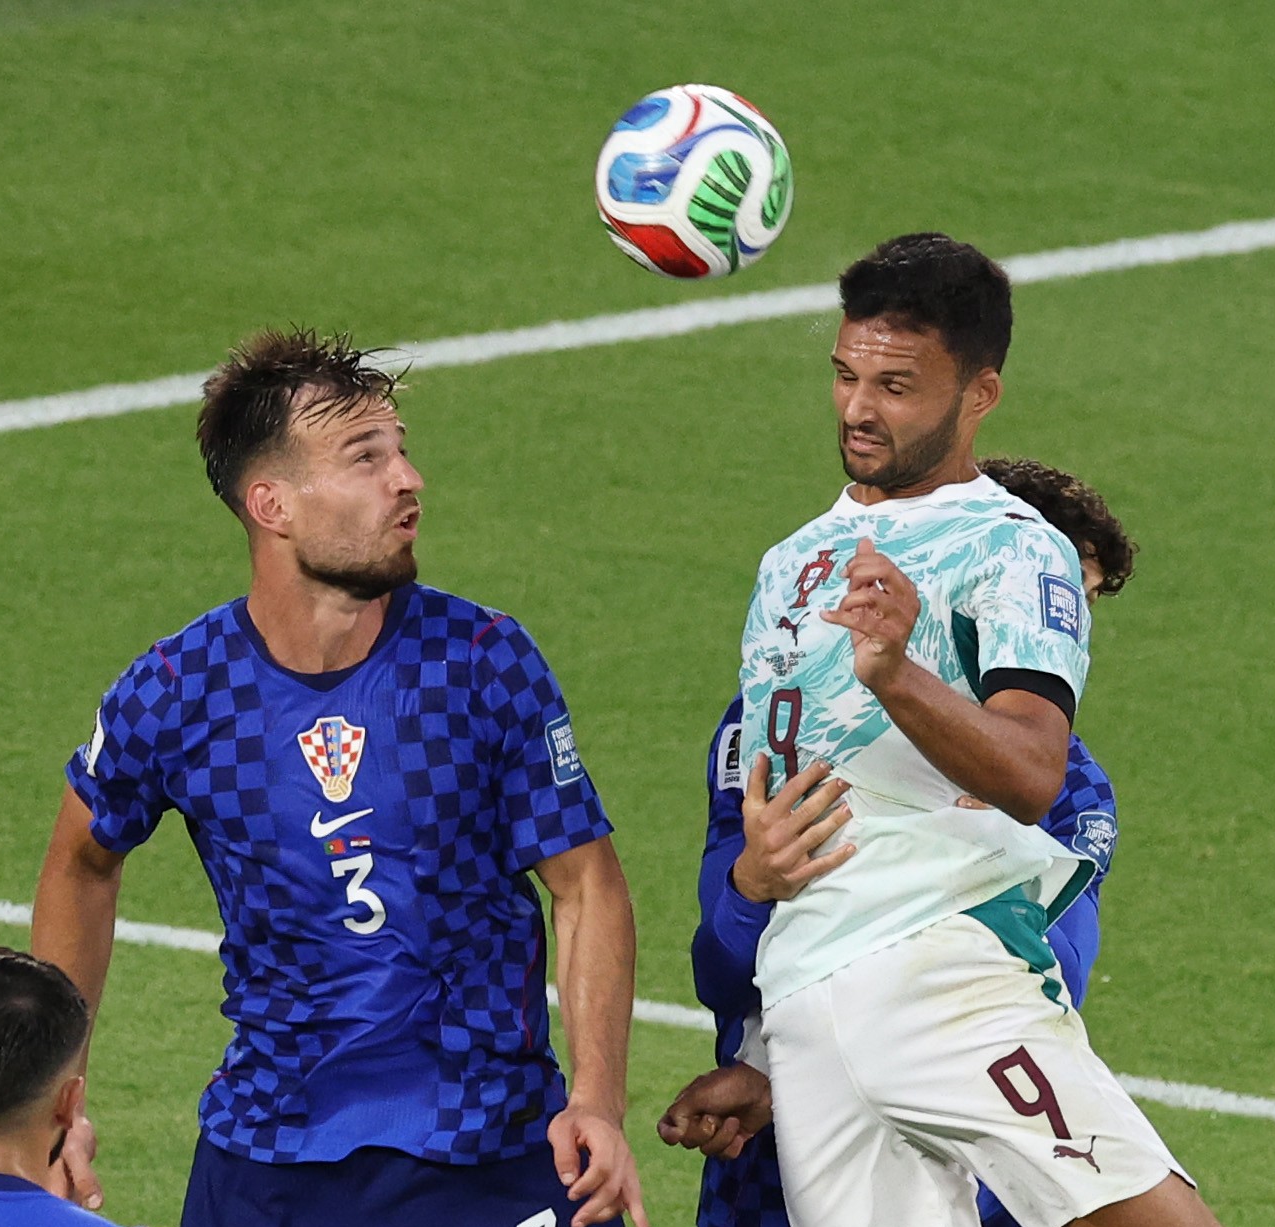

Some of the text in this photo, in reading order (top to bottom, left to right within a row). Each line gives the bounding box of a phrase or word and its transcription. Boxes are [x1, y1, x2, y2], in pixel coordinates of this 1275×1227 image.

[1050, 592, 1077, 616] UNITES
[767, 686, 802, 783] 9
[330, 852, 386, 935] 3
[987, 1044, 1072, 1140] 9
